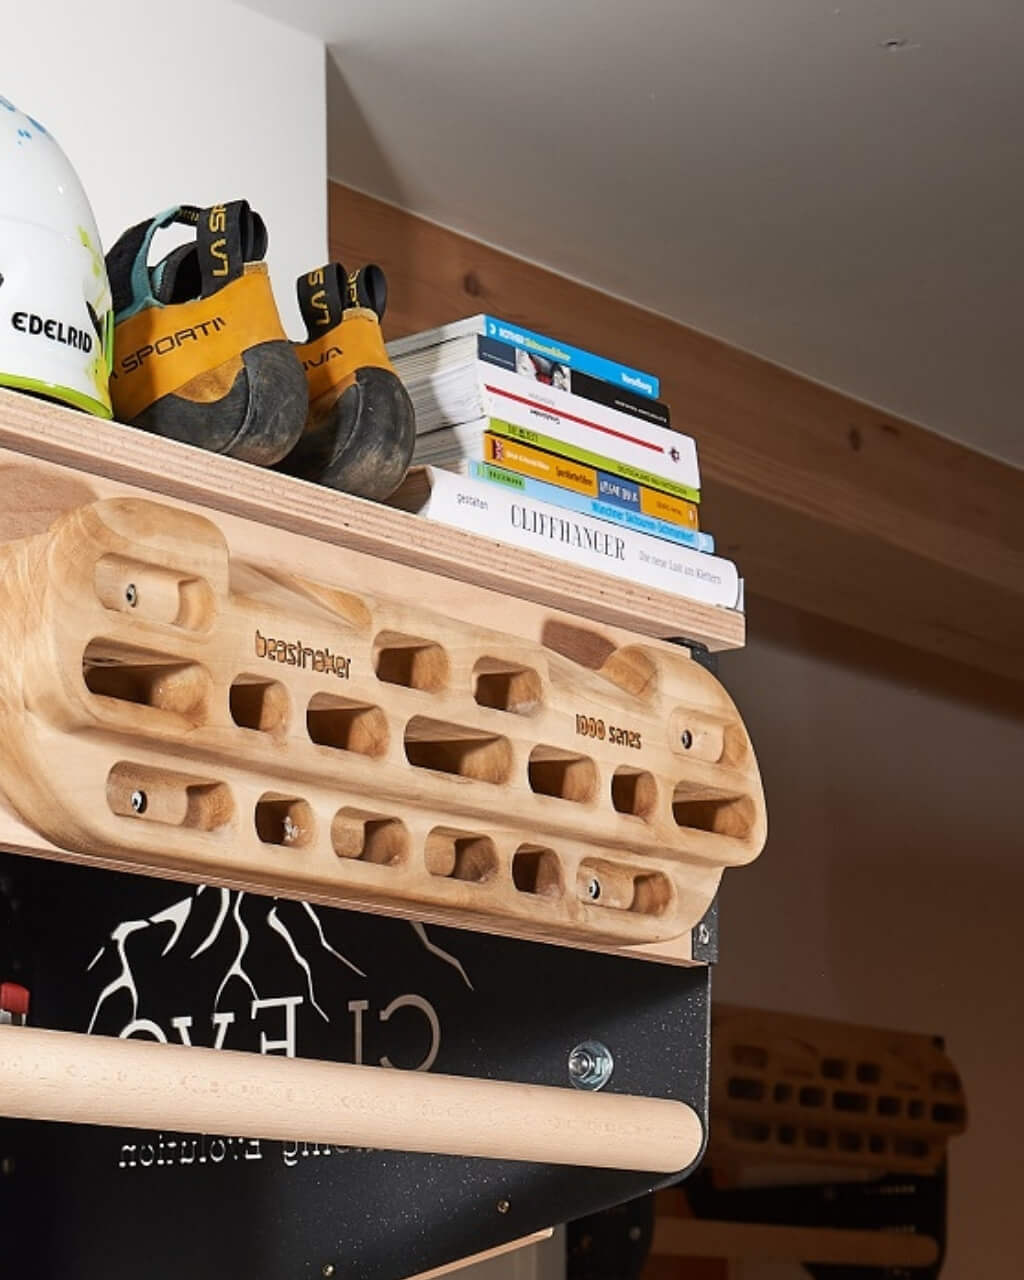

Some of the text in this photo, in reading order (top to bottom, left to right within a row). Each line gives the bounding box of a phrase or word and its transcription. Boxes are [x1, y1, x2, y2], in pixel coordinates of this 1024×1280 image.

[11, 311, 93, 353] EDELRID
[510, 502, 626, 562] CLIFFHANGER
[255, 629, 351, 679] beastmaker
[576, 713, 606, 741] 1000
